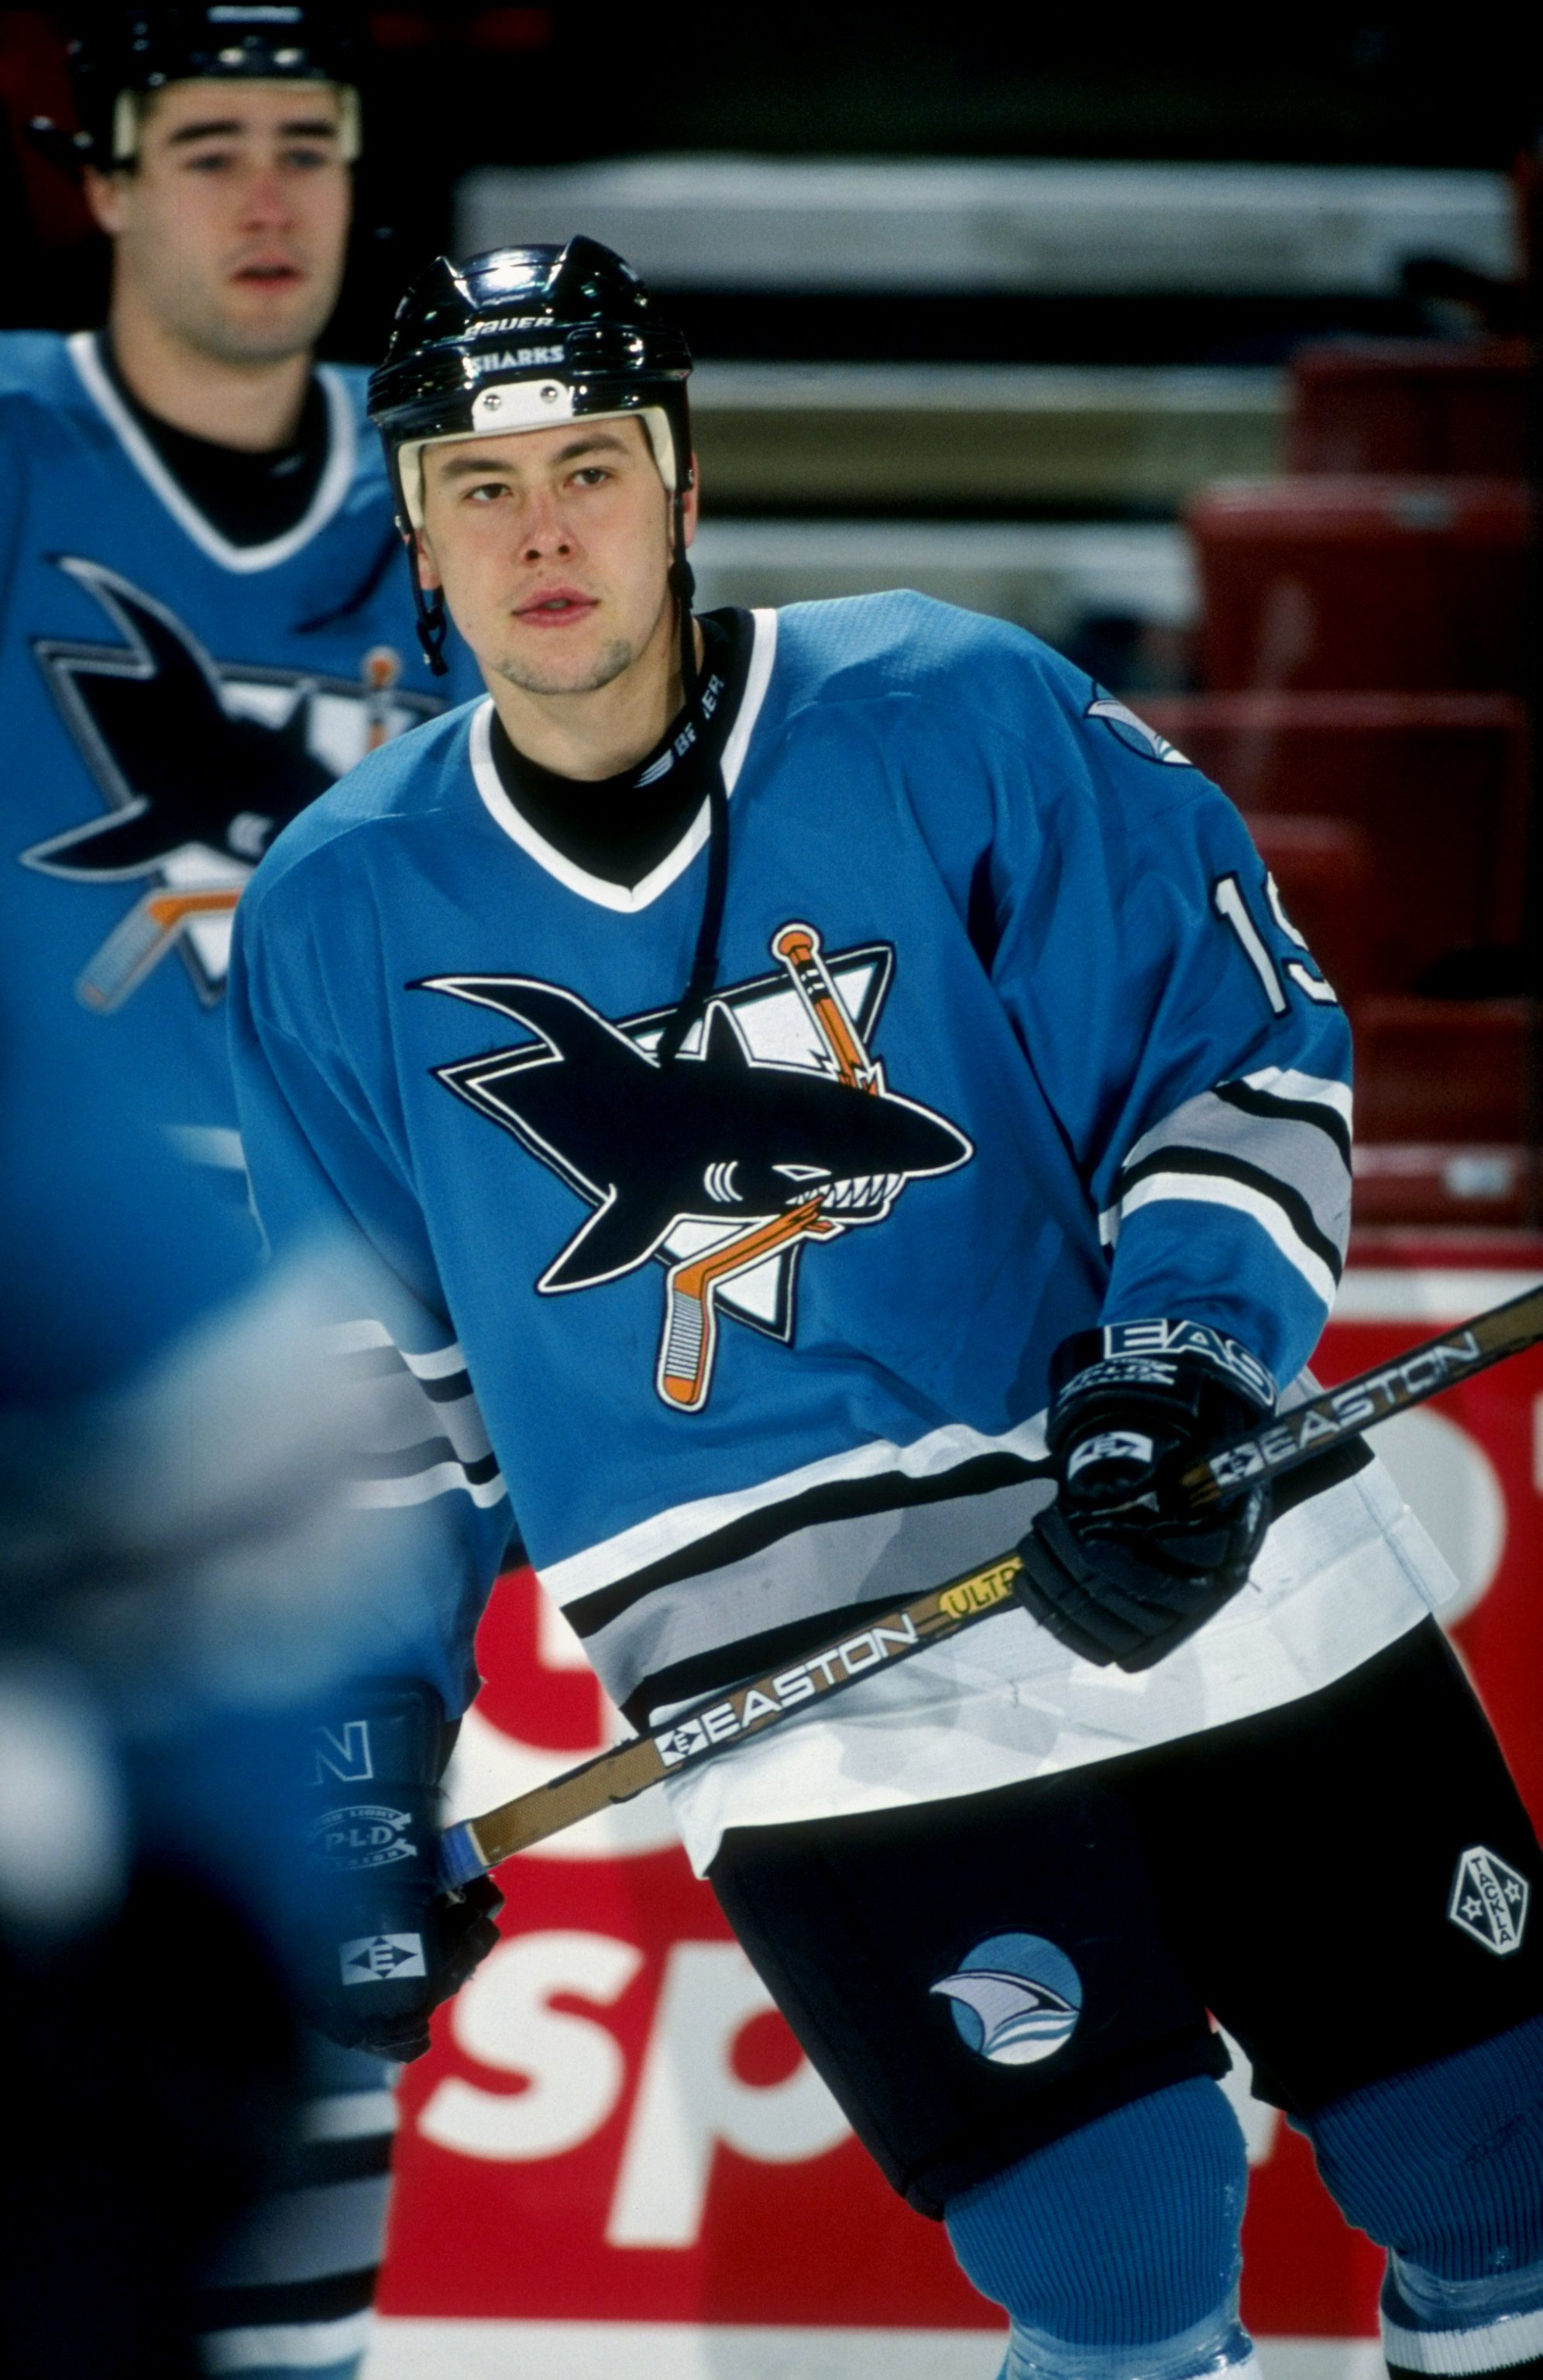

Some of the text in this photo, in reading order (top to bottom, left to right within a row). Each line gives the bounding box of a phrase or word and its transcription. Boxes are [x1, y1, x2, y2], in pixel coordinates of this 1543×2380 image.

[464, 317, 555, 338] BAUER
[468, 346, 565, 372] SHARKS
[1259, 1330, 1481, 1466] EASTON
[701, 1613, 919, 1743] EASTON
[1470, 1857, 1513, 1945] TACKLA
